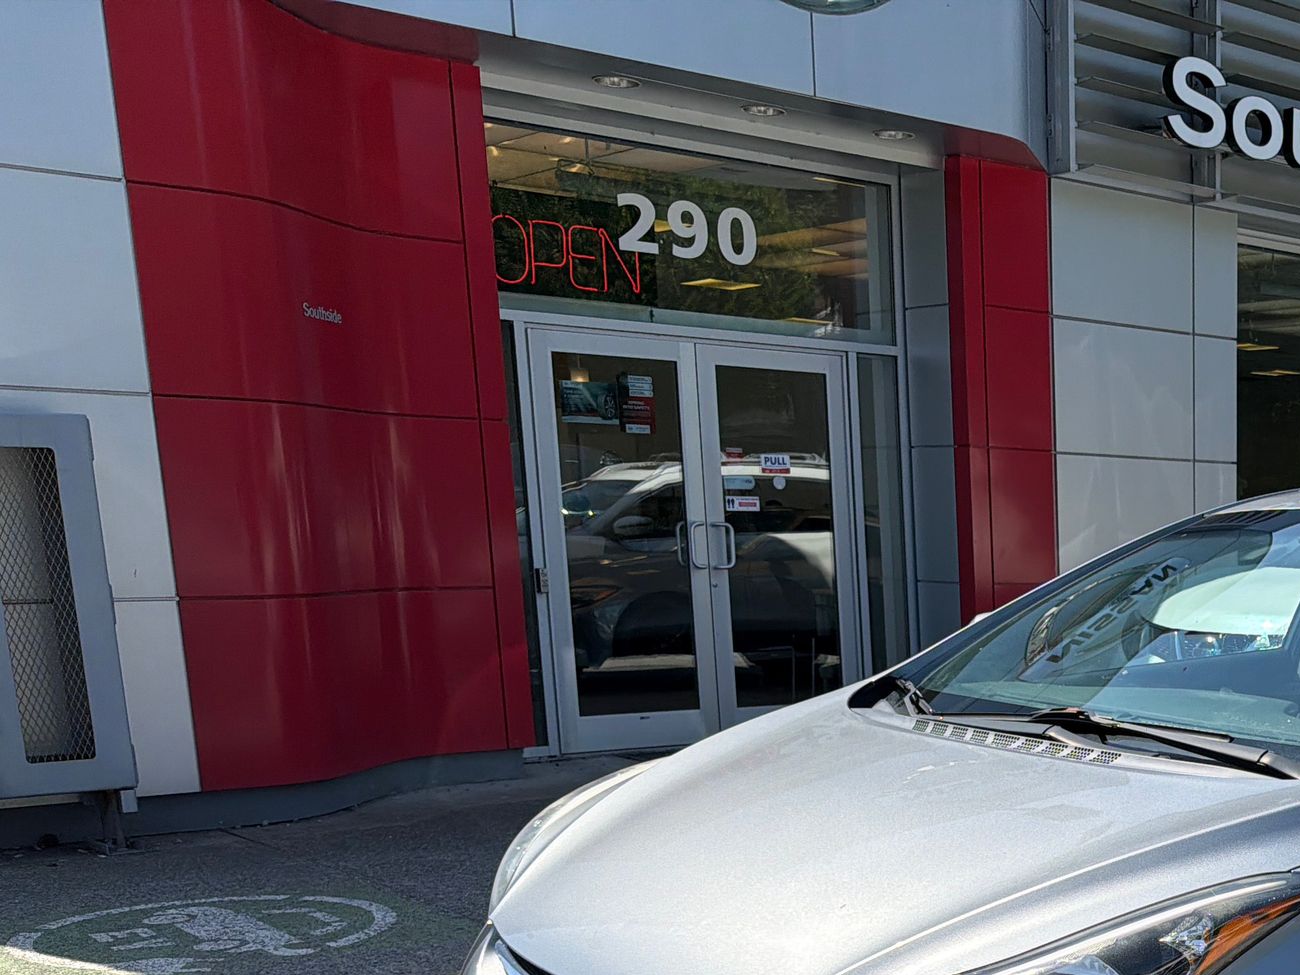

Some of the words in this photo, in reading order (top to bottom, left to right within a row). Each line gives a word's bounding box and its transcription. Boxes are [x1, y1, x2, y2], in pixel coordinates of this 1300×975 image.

[616, 193, 758, 266] 290
[491, 214, 641, 294] OPEN
[302, 302, 343, 325] Southside
[764, 456, 787, 466] PULL
